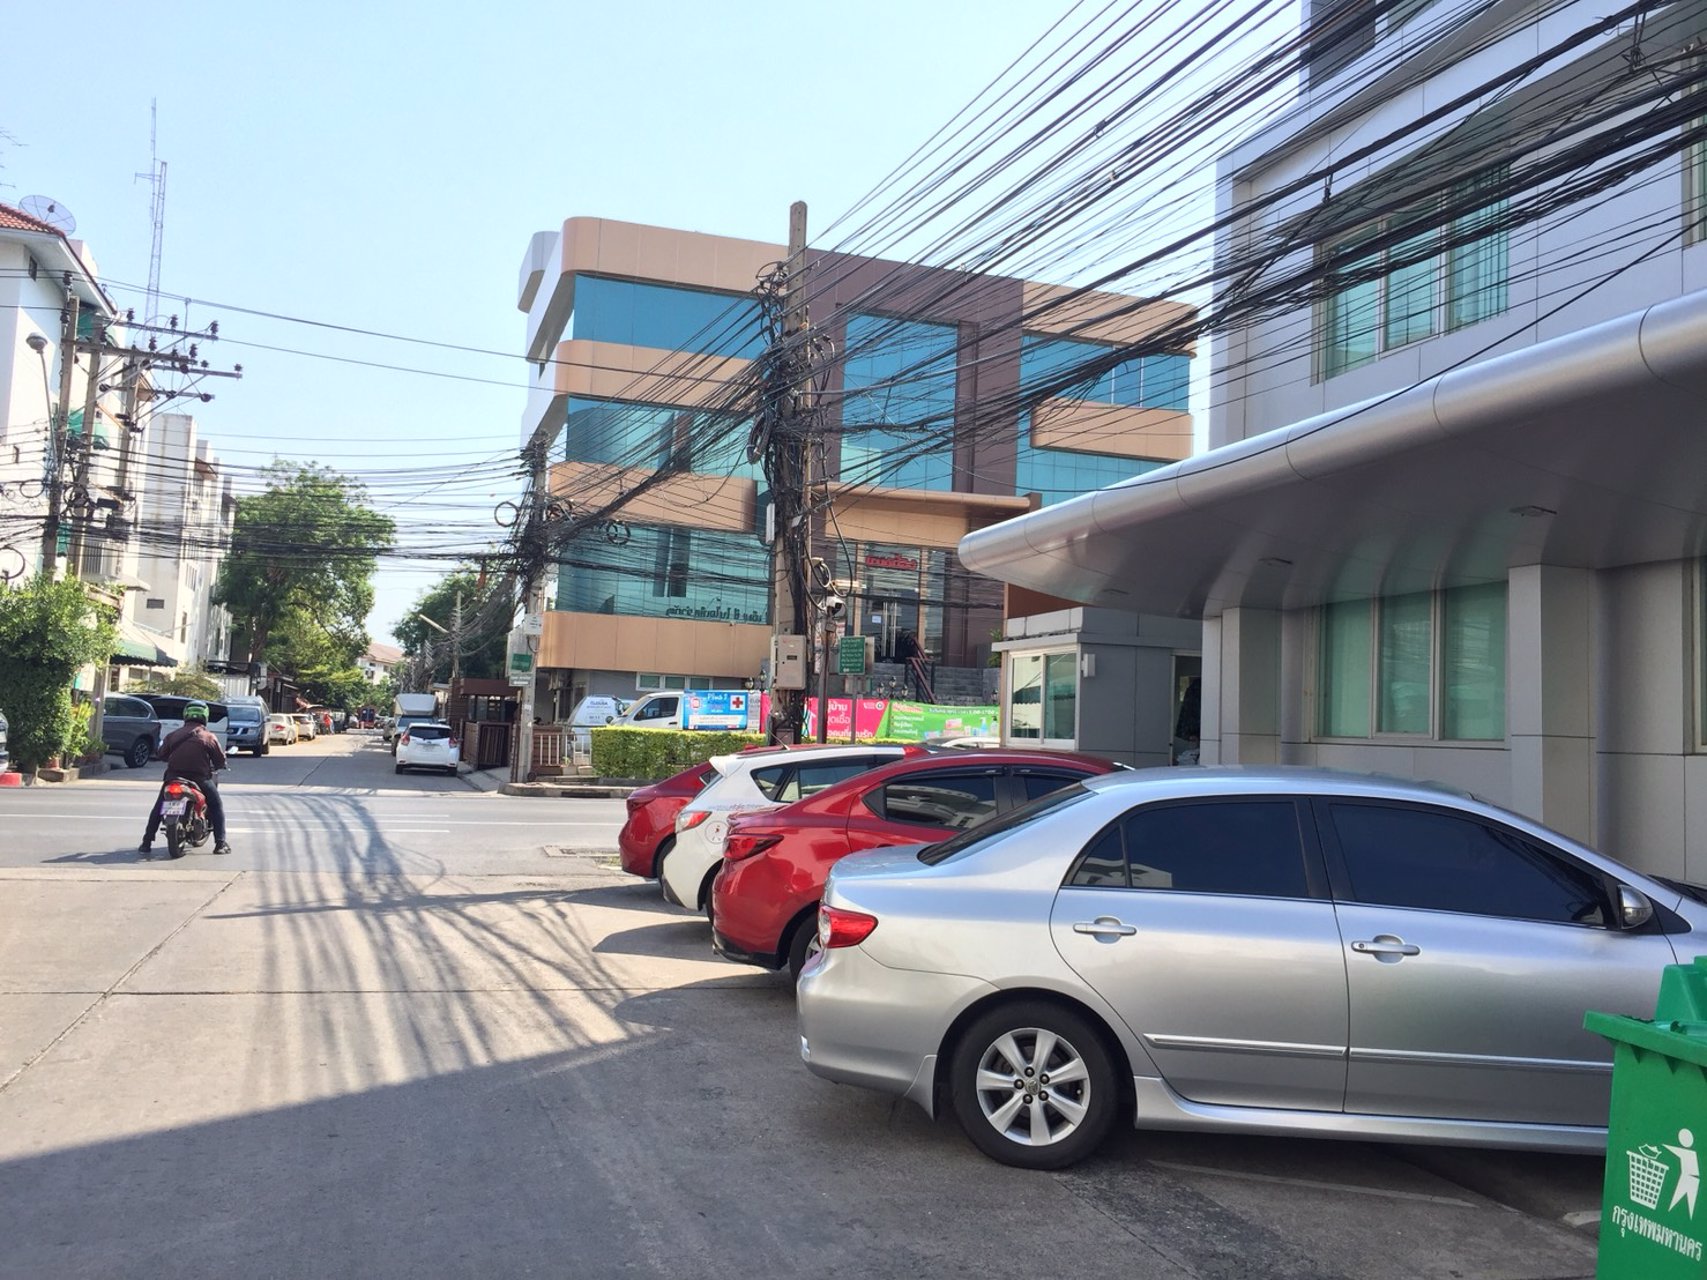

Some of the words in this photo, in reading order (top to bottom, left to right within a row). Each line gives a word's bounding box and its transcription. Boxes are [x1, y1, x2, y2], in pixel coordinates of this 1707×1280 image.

[1612, 1205, 1703, 1262] กรุงเทพมหานคร
